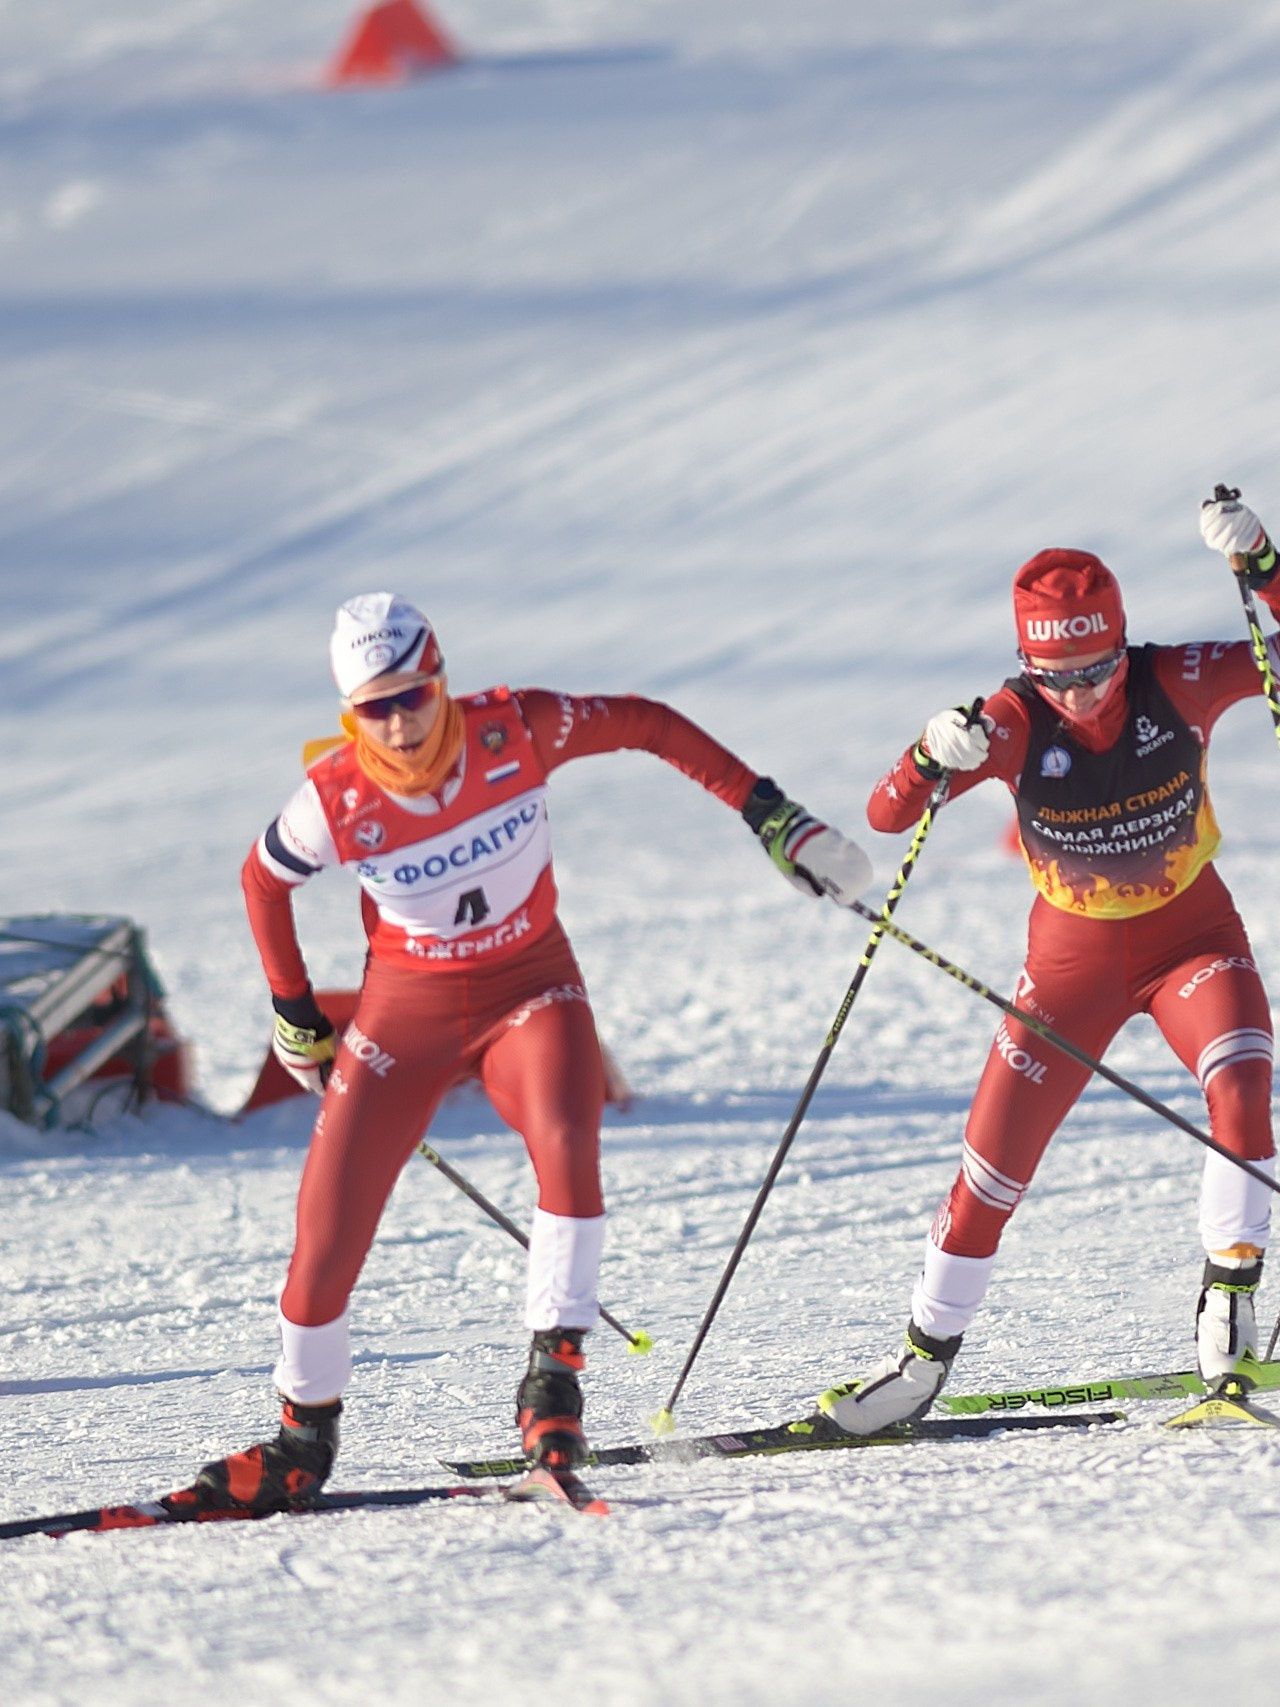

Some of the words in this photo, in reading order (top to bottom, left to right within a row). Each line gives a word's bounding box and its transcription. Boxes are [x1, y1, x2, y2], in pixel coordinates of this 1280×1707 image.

[1027, 612, 1109, 641] LUKOIL
[1031, 820, 1103, 843] САМАЯ
[1110, 788, 1195, 839] ДЕРЗКАЯ
[1038, 801, 1122, 824] ЛЫЖНАЯ
[1126, 771, 1190, 812] СТРАНА
[394, 802, 538, 884] ФОСАГРО
[1062, 825, 1176, 855] ЛЫЖНИЦА
[987, 1384, 1113, 1411] FISCHER
